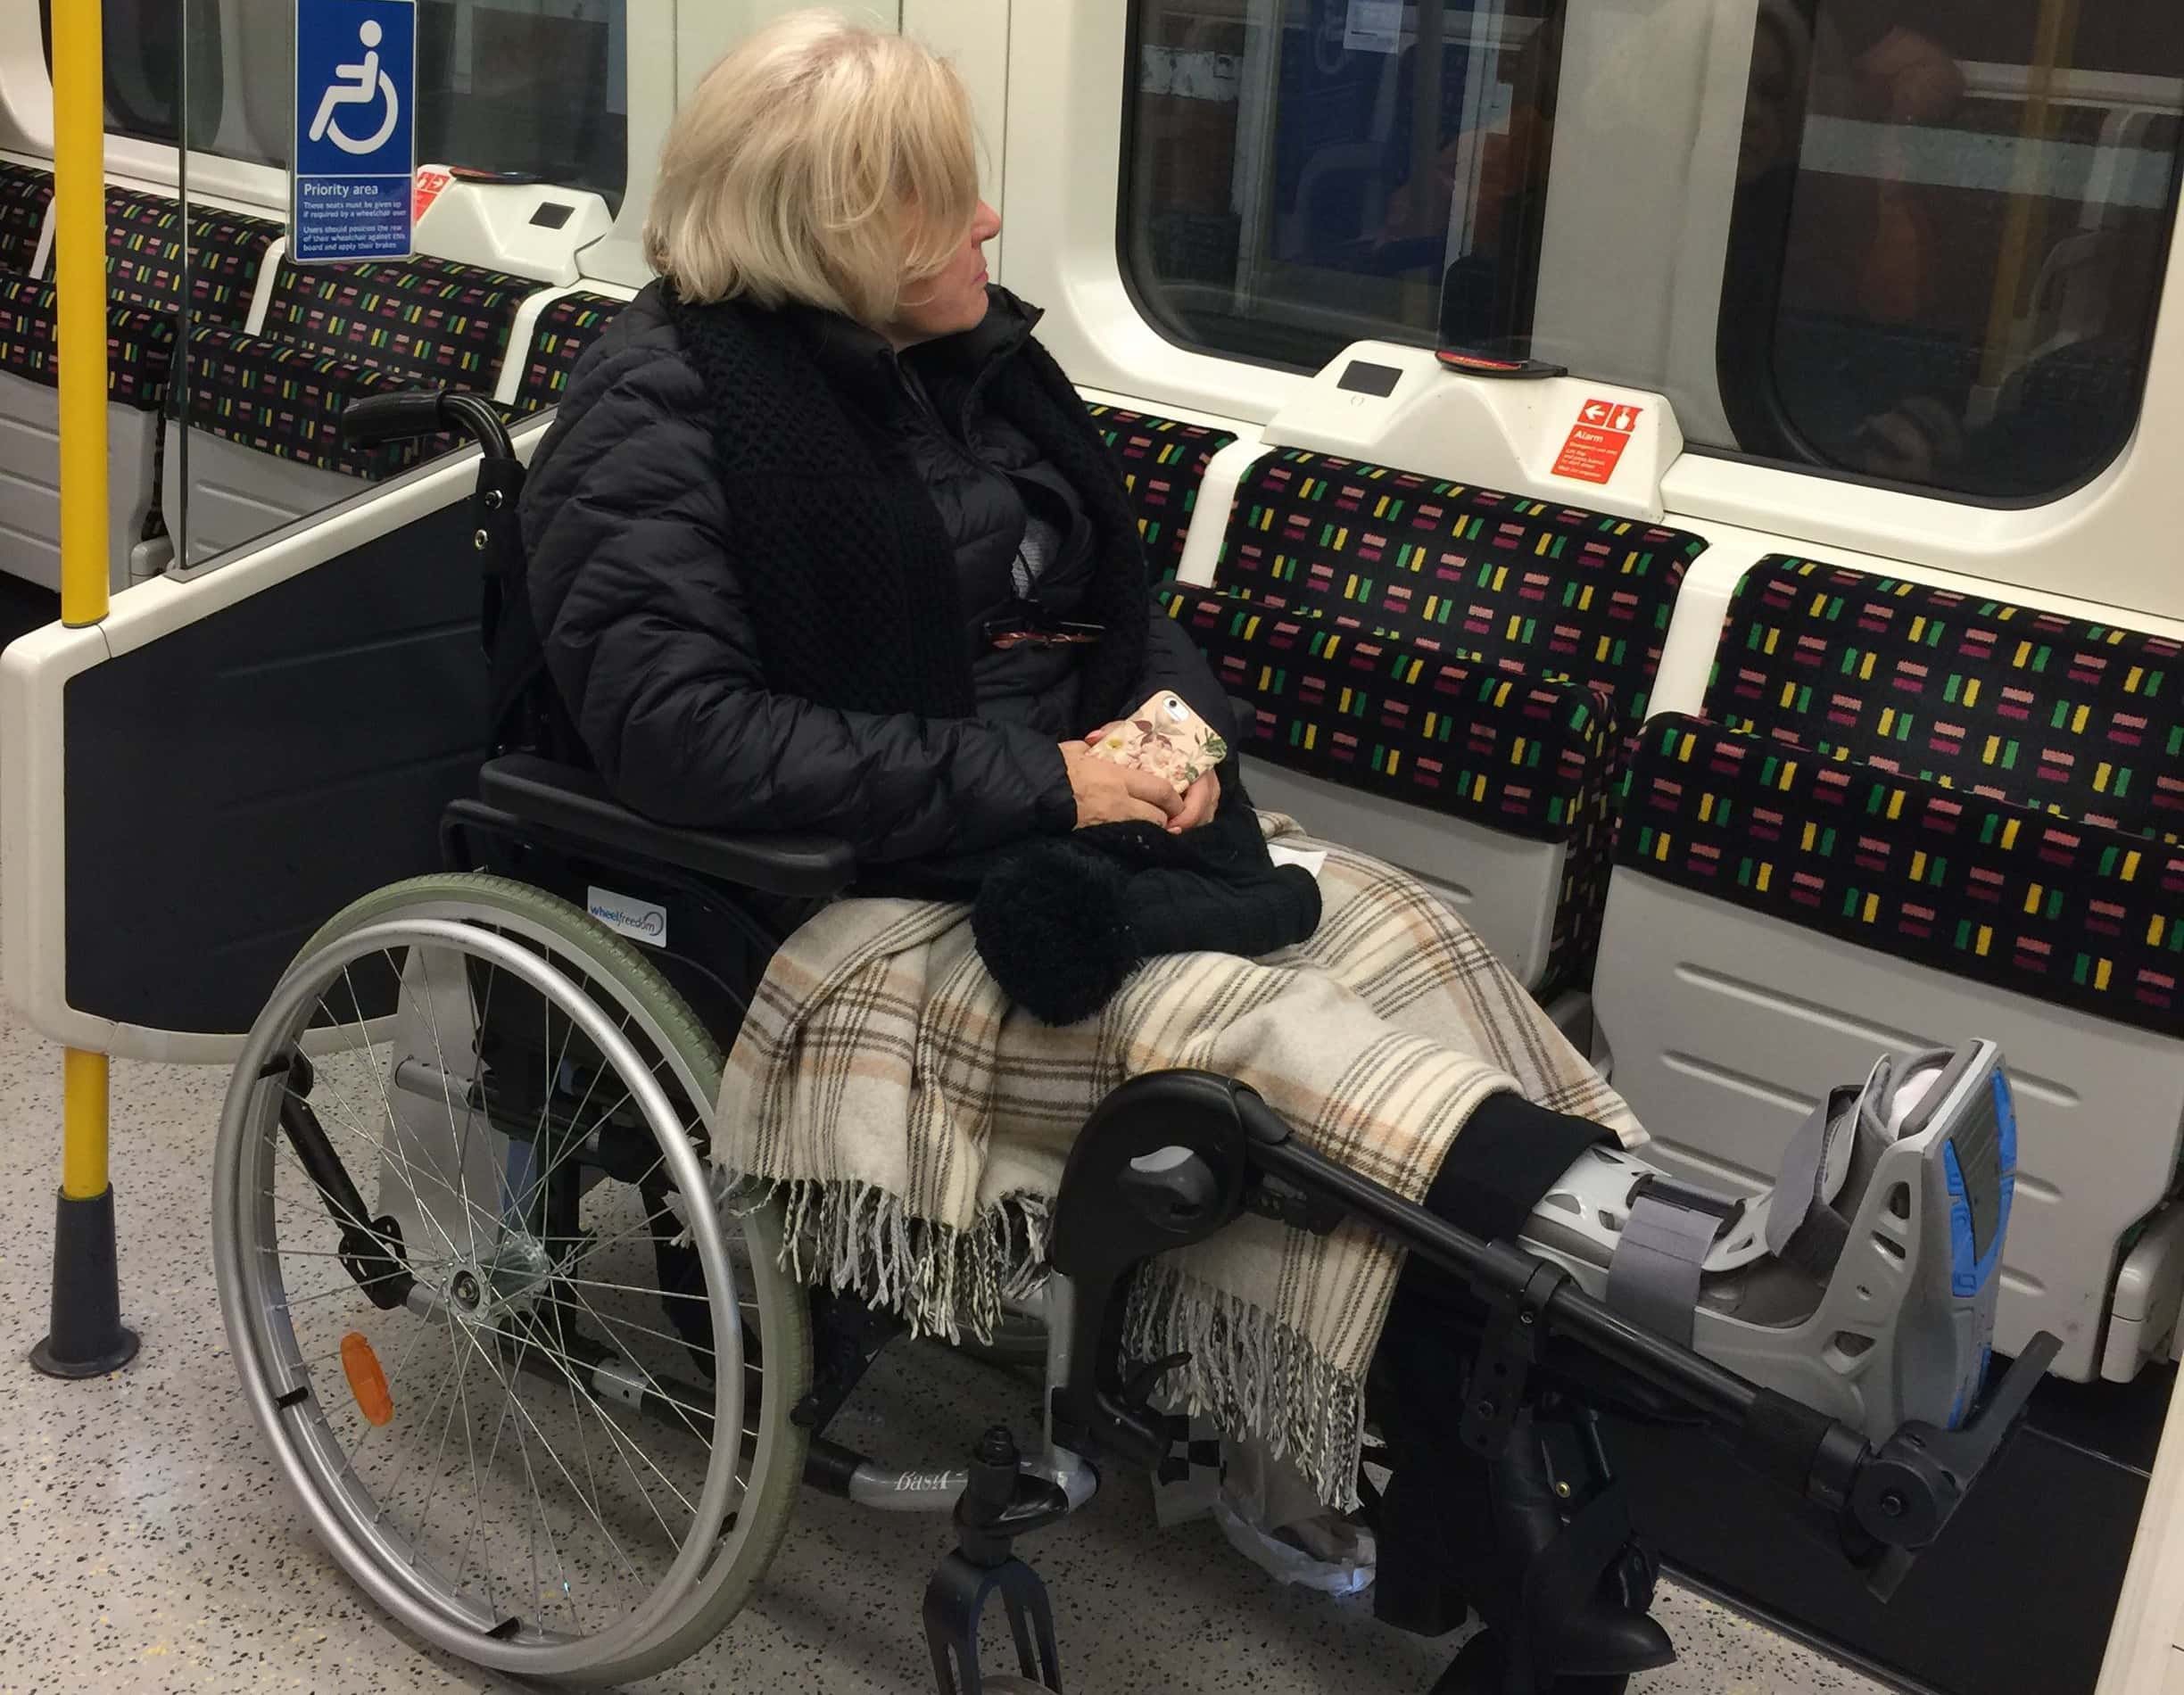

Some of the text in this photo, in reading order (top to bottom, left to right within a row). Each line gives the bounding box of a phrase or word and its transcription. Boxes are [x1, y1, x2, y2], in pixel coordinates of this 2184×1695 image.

[304, 184, 378, 197] Priority area
[310, 211, 338, 219] required
[340, 211, 349, 219] by
[338, 243, 357, 251] apply
[1574, 430, 1604, 442] Alarm
